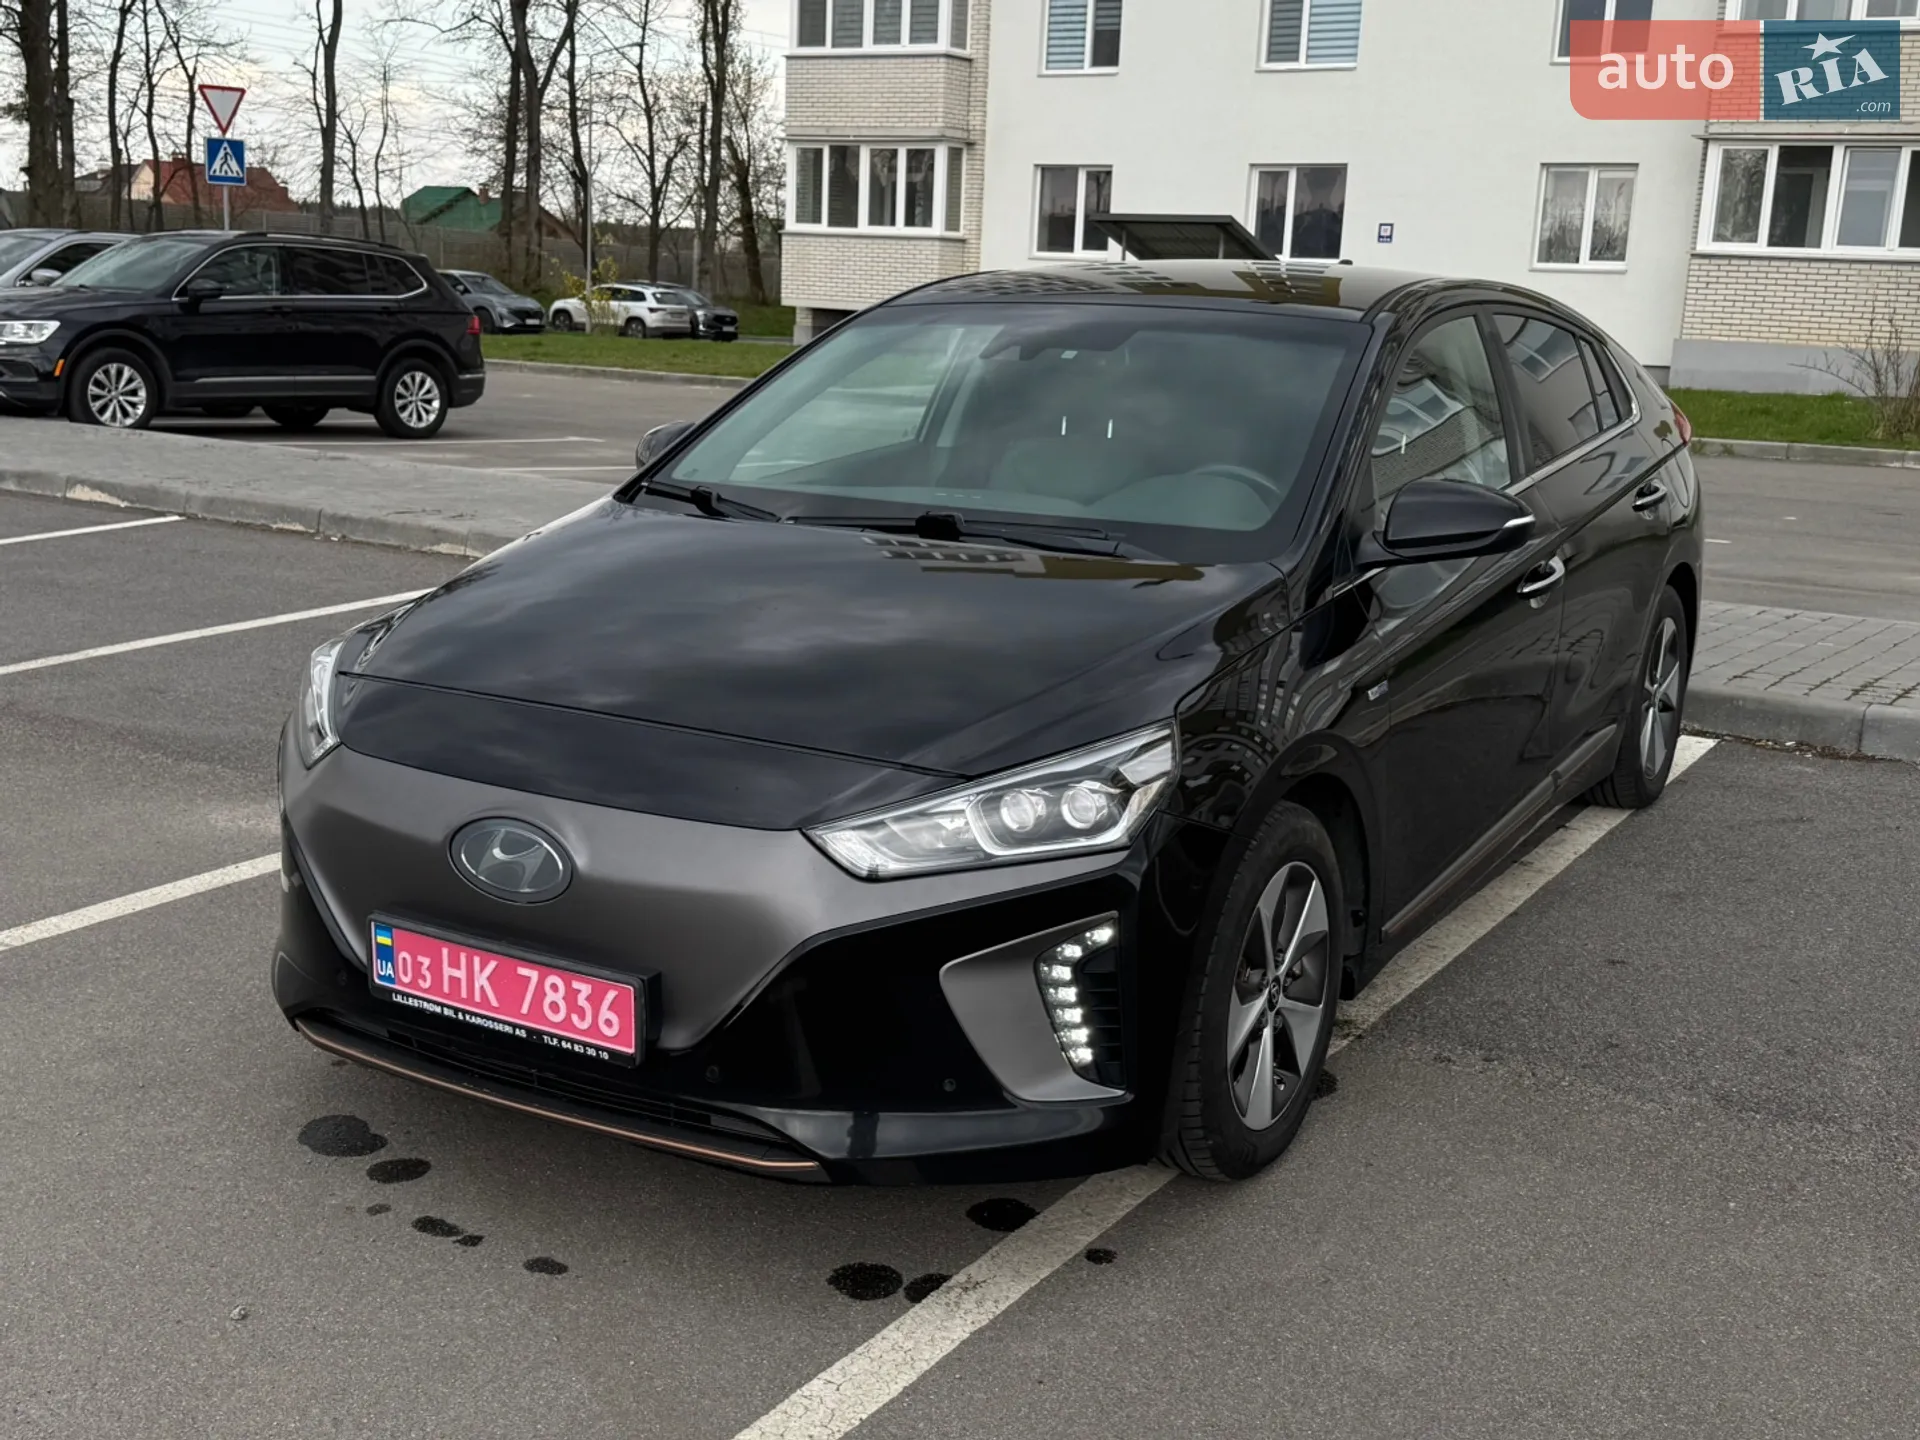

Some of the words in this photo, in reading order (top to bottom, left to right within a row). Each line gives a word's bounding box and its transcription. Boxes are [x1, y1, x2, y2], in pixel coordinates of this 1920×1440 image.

[377, 958, 395, 979] UA
[398, 950, 432, 990] 03
[441, 947, 500, 1008] HK
[516, 966, 620, 1038] 7836
[443, 1006, 457, 1019] BIL
[514, 1027, 527, 1038] AS
